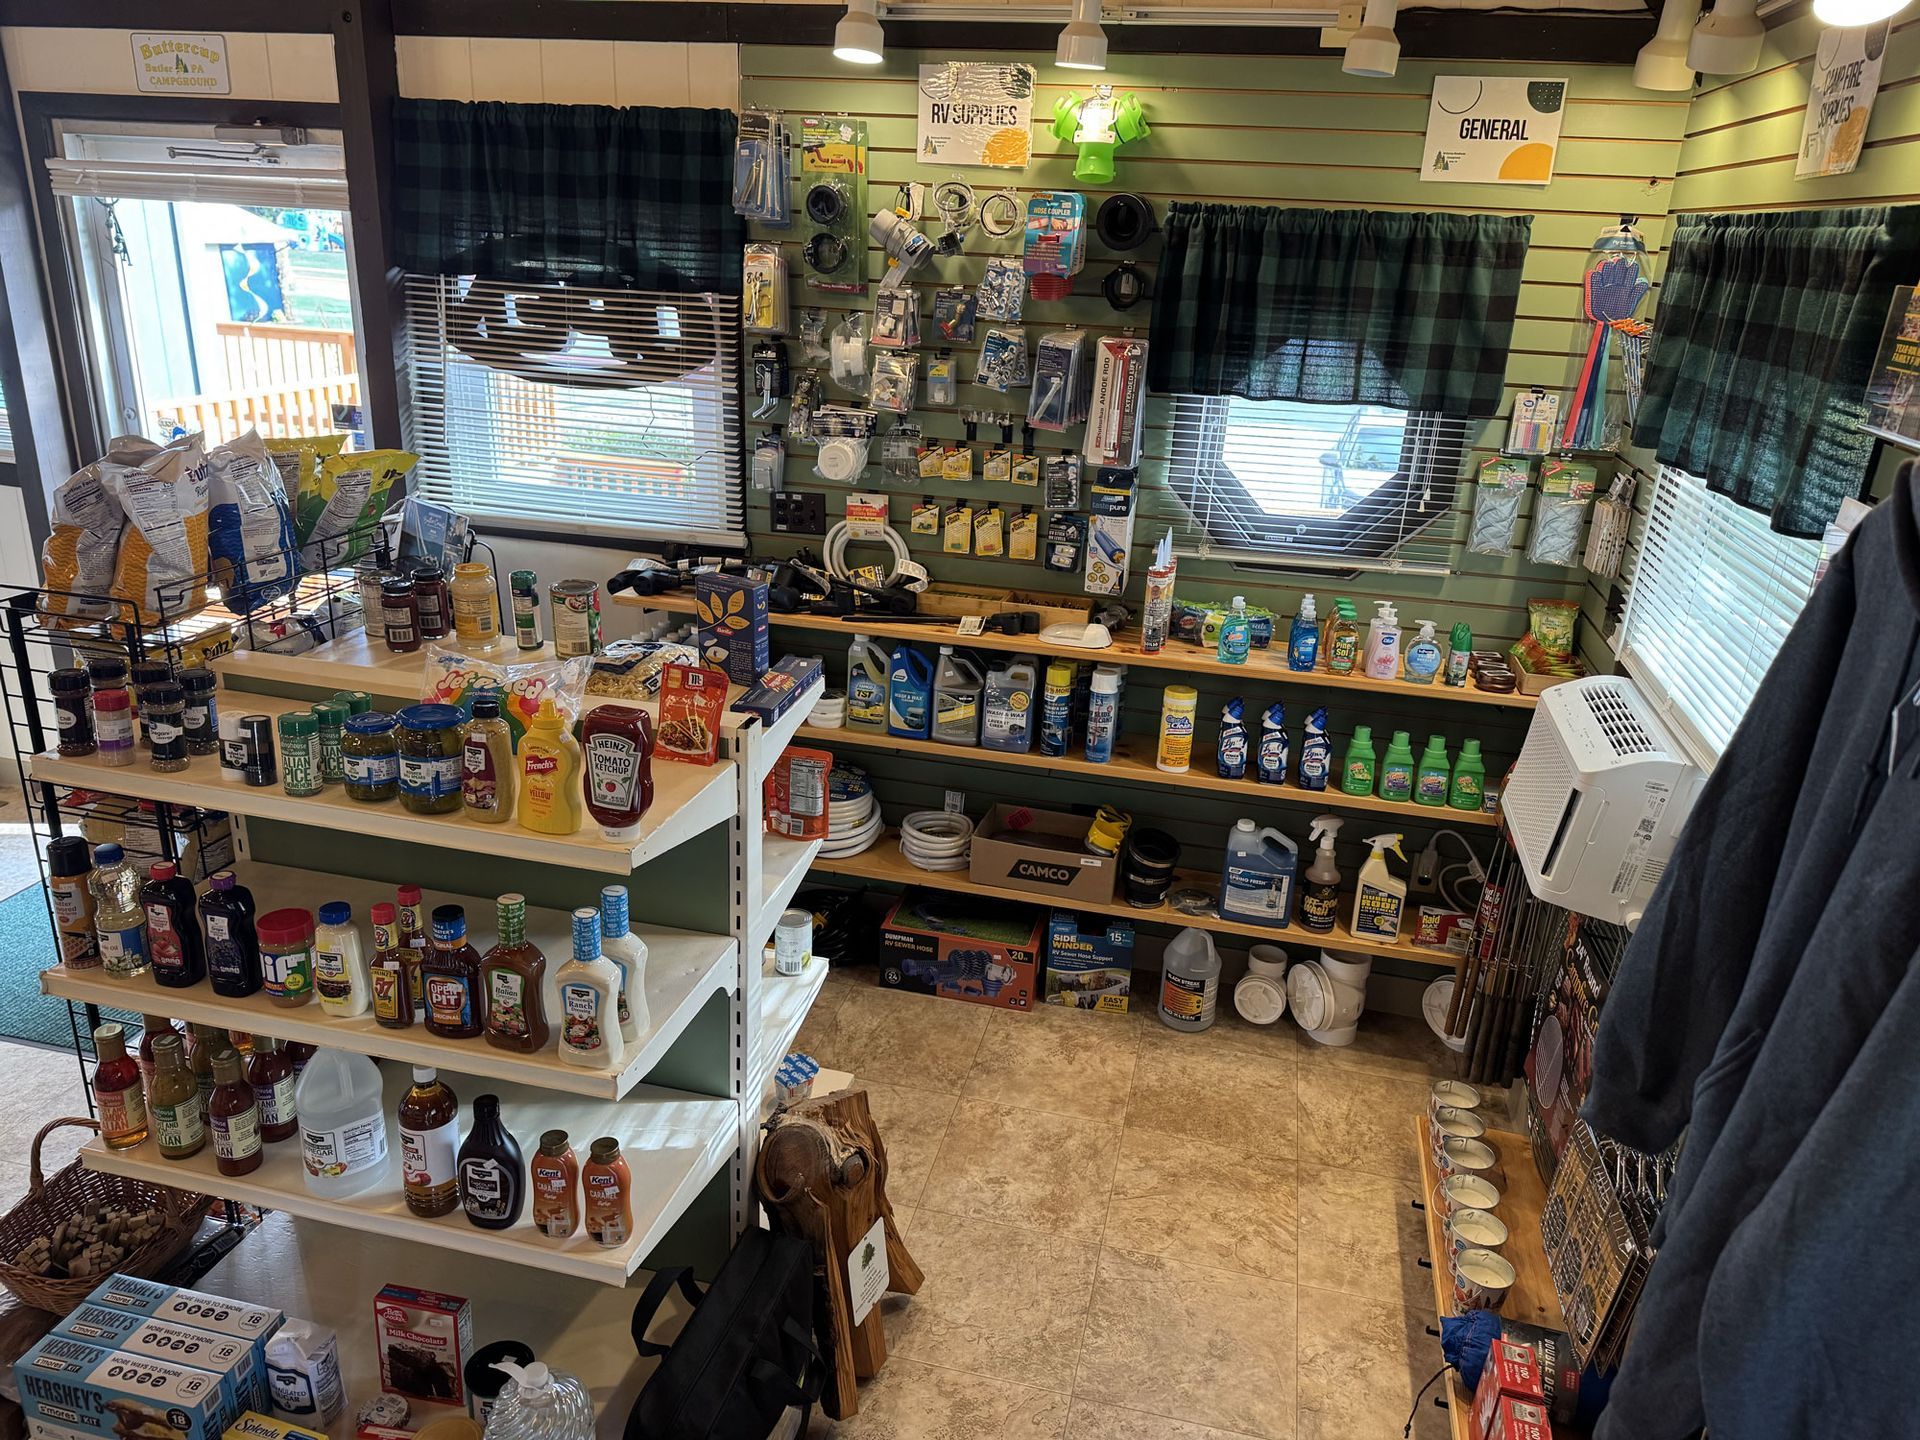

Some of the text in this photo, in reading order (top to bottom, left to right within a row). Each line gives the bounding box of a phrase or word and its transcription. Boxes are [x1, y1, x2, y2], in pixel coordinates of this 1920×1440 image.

[139, 40, 220, 64] Buttercup
[190, 64, 204, 73] PA
[149, 76, 218, 87] CAMPGROUND
[1823, 59, 1866, 96] CAMPFIRE
[931, 103, 1018, 126] RV SUPPLIES
[1818, 95, 1855, 128] SUPPLIES
[1459, 118, 1529, 141] GENERAL
[1102, 356, 1111, 375] ROD
[1098, 374, 1109, 406] ANODE
[1124, 374, 1136, 413] EXTENDED
[857, 690, 874, 698] TST
[597, 740, 626, 752] HEINZ
[526, 758, 554, 771] French's
[593, 752, 631, 768] TOMATO
[594, 763, 629, 775] KETCHUP
[529, 790, 551, 800] YELLOW
[1018, 863, 1070, 881] CAMCO
[1362, 900, 1399, 911] ROOF
[1421, 921, 1439, 930] MAX
[1422, 914, 1441, 925] Raid
[884, 933, 914, 943] DUMPMAN
[1053, 934, 1077, 943] SIDE
[894, 942, 916, 950] SEWER
[916, 945, 934, 953] HOSE
[1052, 940, 1094, 951] WINDER
[1011, 951, 1024, 960] 20
[1092, 954, 1114, 962] Support
[1566, 948, 1589, 1014] Campfire
[1583, 954, 1602, 1001] Round
[374, 978, 394, 997] 57
[495, 986, 518, 998] Italian
[432, 994, 458, 1006] PIT
[568, 1001, 593, 1010] Ranch
[1103, 996, 1124, 1004] EASY
[538, 1169, 560, 1178] Kent
[591, 1176, 613, 1184] Kent
[108, 1278, 165, 1300] HERSHEY'S
[103, 1292, 149, 1308] s'mores KIT
[175, 1293, 244, 1313] MORE WAYS TO S'MORE
[75, 1306, 140, 1331] HERSHEY'S
[247, 1315, 263, 1325] 18
[70, 1325, 118, 1340] s'mores KIT
[145, 1324, 164, 1333] MORE
[164, 1328, 181, 1336] WAYS
[190, 1333, 215, 1345] S'MORE
[389, 1328, 445, 1345] Milk Chocolate
[38, 1338, 105, 1364] HERSHEY'S
[218, 1347, 234, 1357] 18
[1544, 1338, 1556, 1377] DOUBLE
[34, 1357, 81, 1373] s'mores KIT
[111, 1356, 183, 1378] MORE WAYS TO S'MORE
[1520, 1366, 1530, 1380] 100
[185, 1379, 202, 1391] 18
[24, 1375, 104, 1415] HERSHEY'S
[39, 1404, 100, 1428] s'mores KIT
[171, 1413, 186, 1426] 18
[235, 1418, 280, 1440] Splenda
